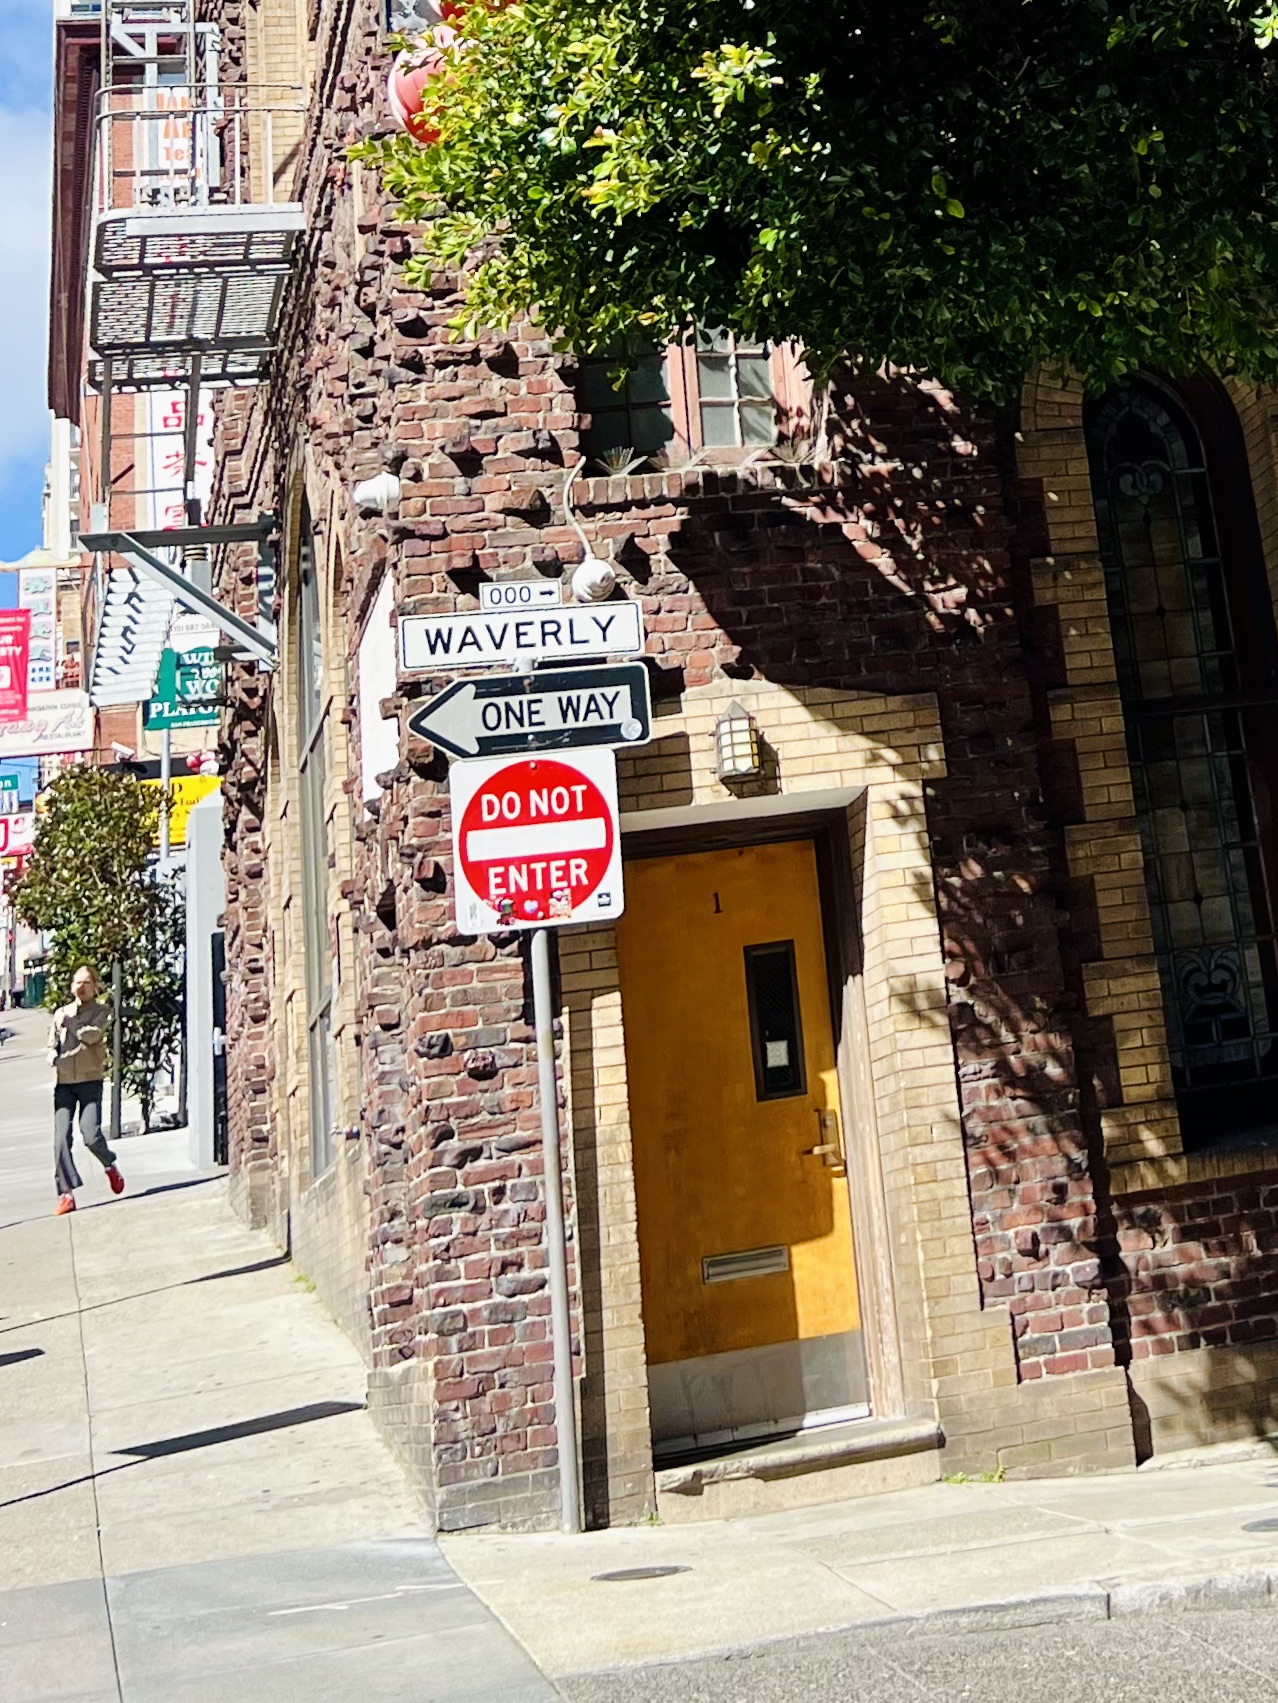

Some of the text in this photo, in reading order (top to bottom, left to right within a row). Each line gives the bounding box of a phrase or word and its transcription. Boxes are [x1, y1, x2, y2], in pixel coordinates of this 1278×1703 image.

[489, 585, 532, 605] 000
[423, 614, 616, 656] WAVERLY
[481, 691, 621, 731] ONE WAY
[480, 784, 588, 822] DO NOT
[488, 857, 589, 895] ENTER
[711, 892, 723, 915] 1
